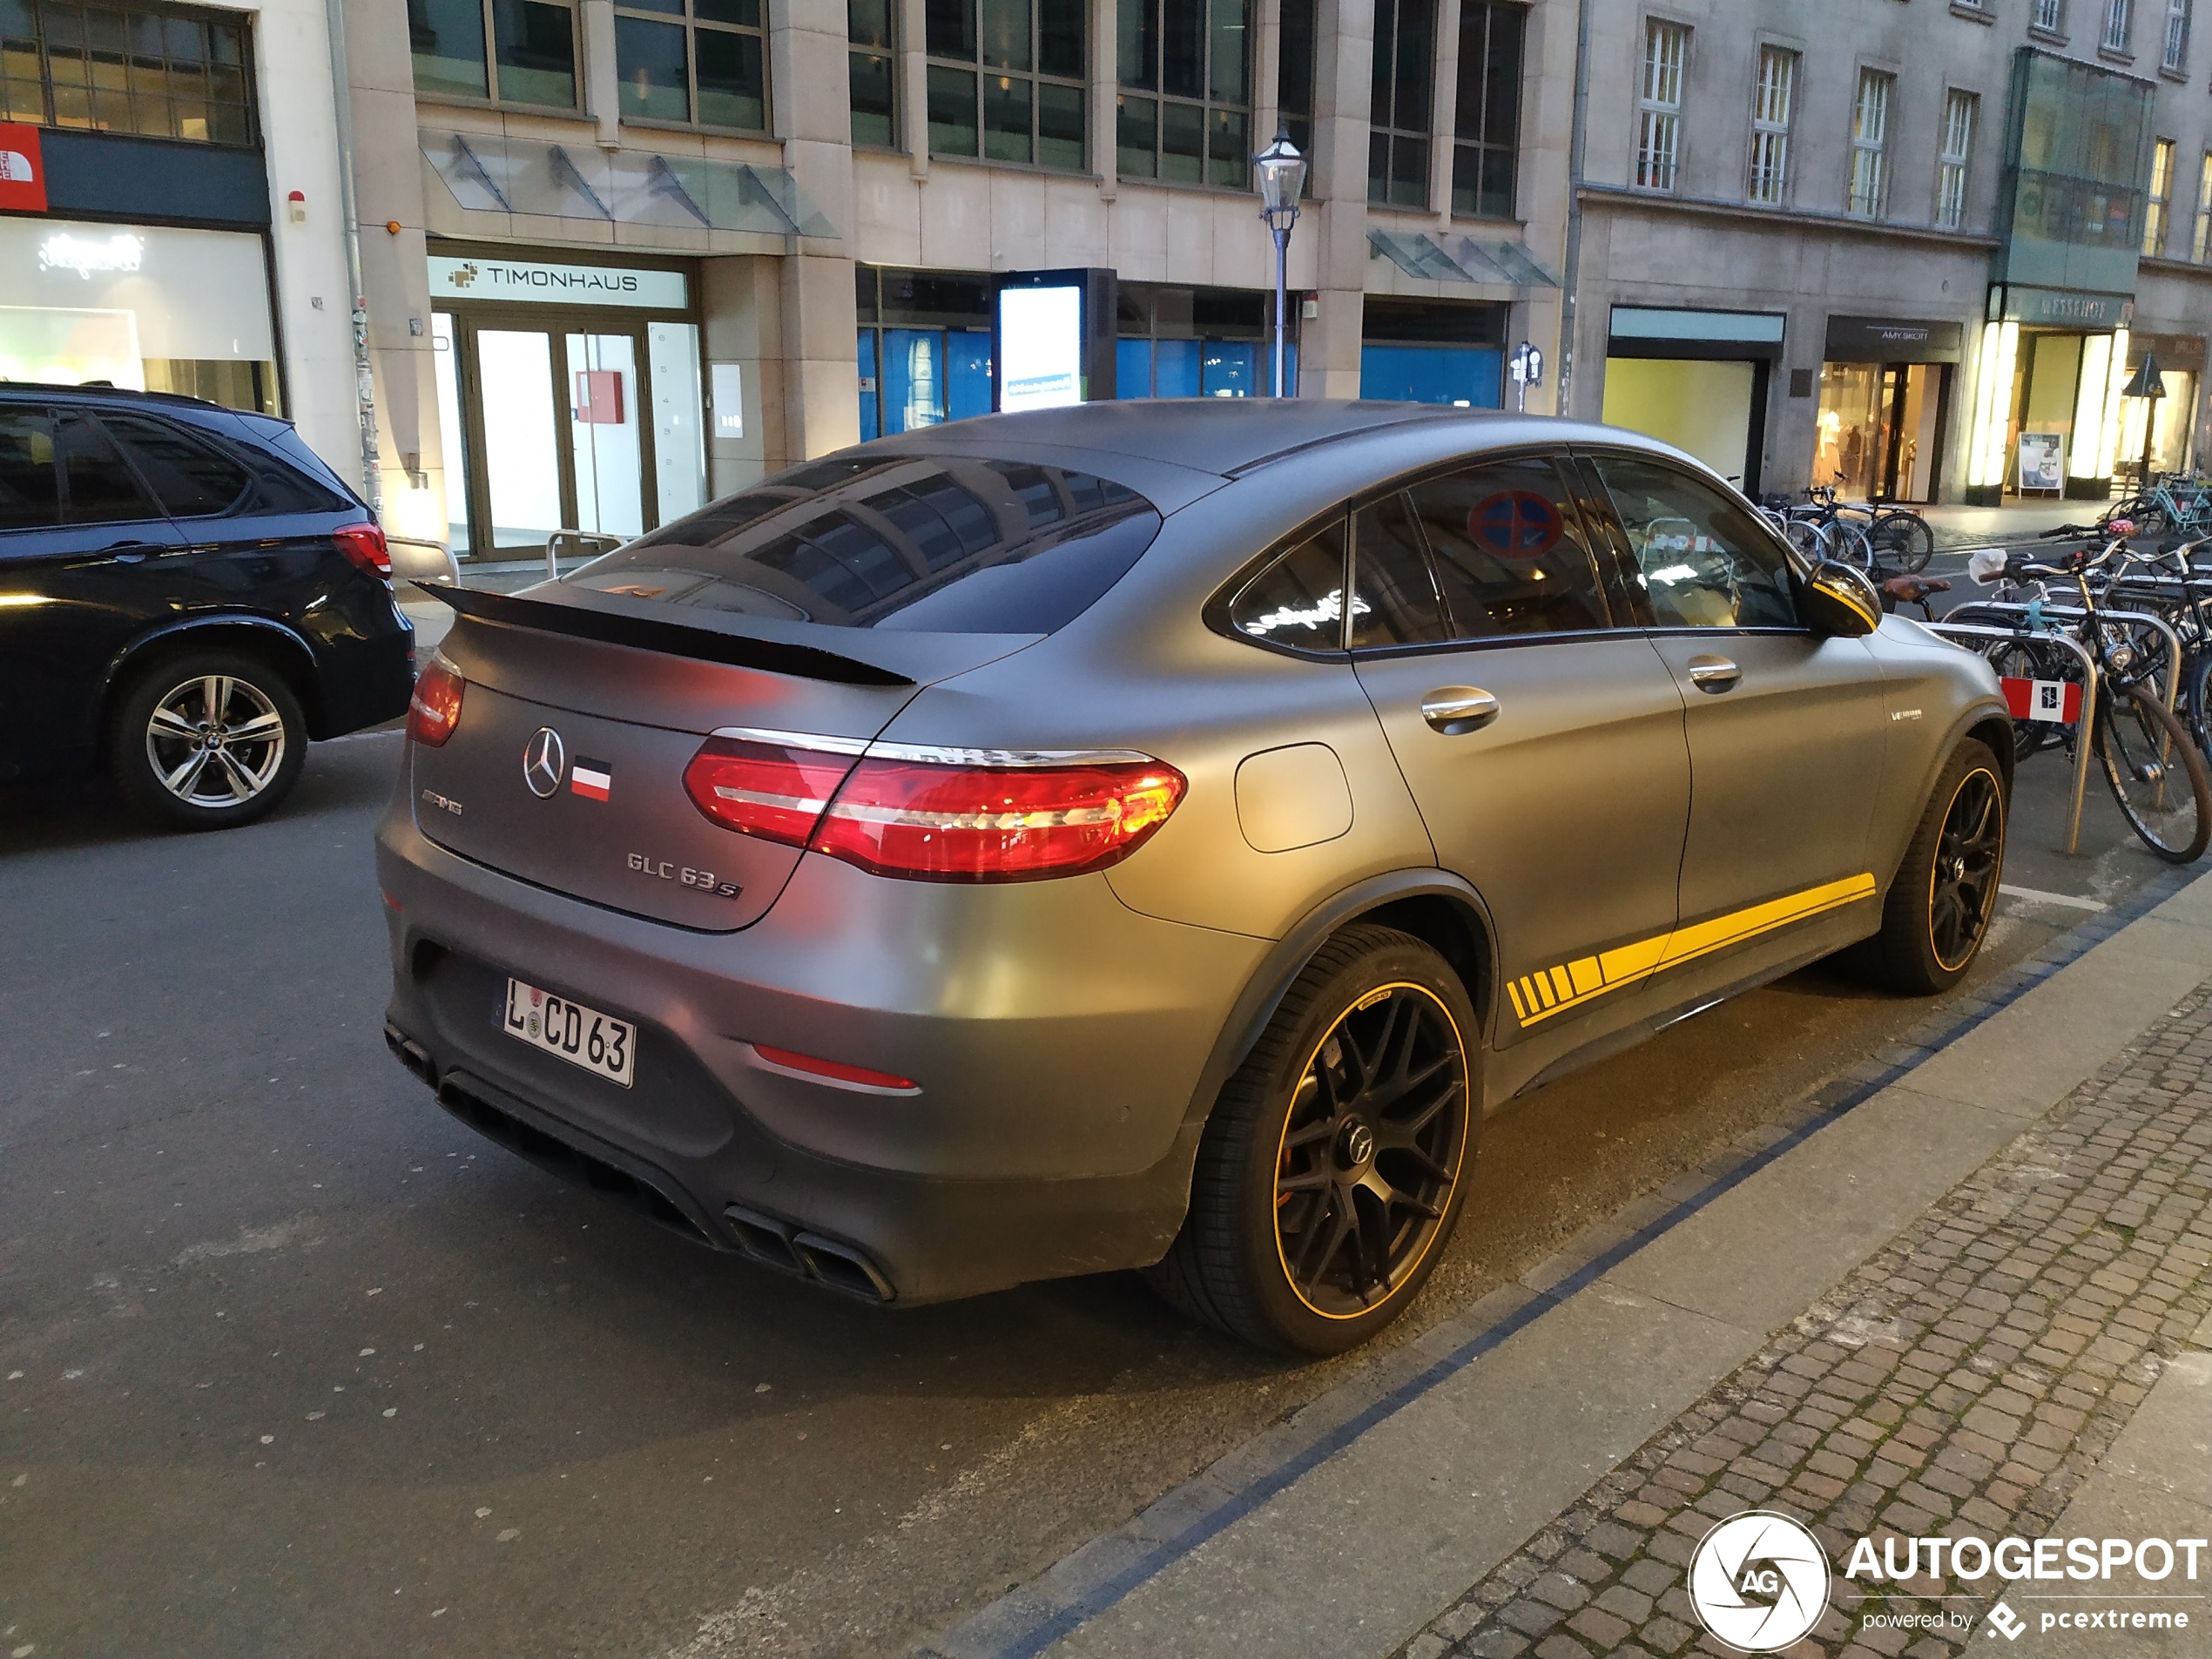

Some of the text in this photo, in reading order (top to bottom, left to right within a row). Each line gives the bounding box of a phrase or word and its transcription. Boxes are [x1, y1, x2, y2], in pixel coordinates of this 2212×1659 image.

[487, 267, 637, 292] TIMONHAUS
[1881, 331, 1901, 340] AMY
[627, 853, 674, 880] GLC
[680, 867, 715, 889] 63
